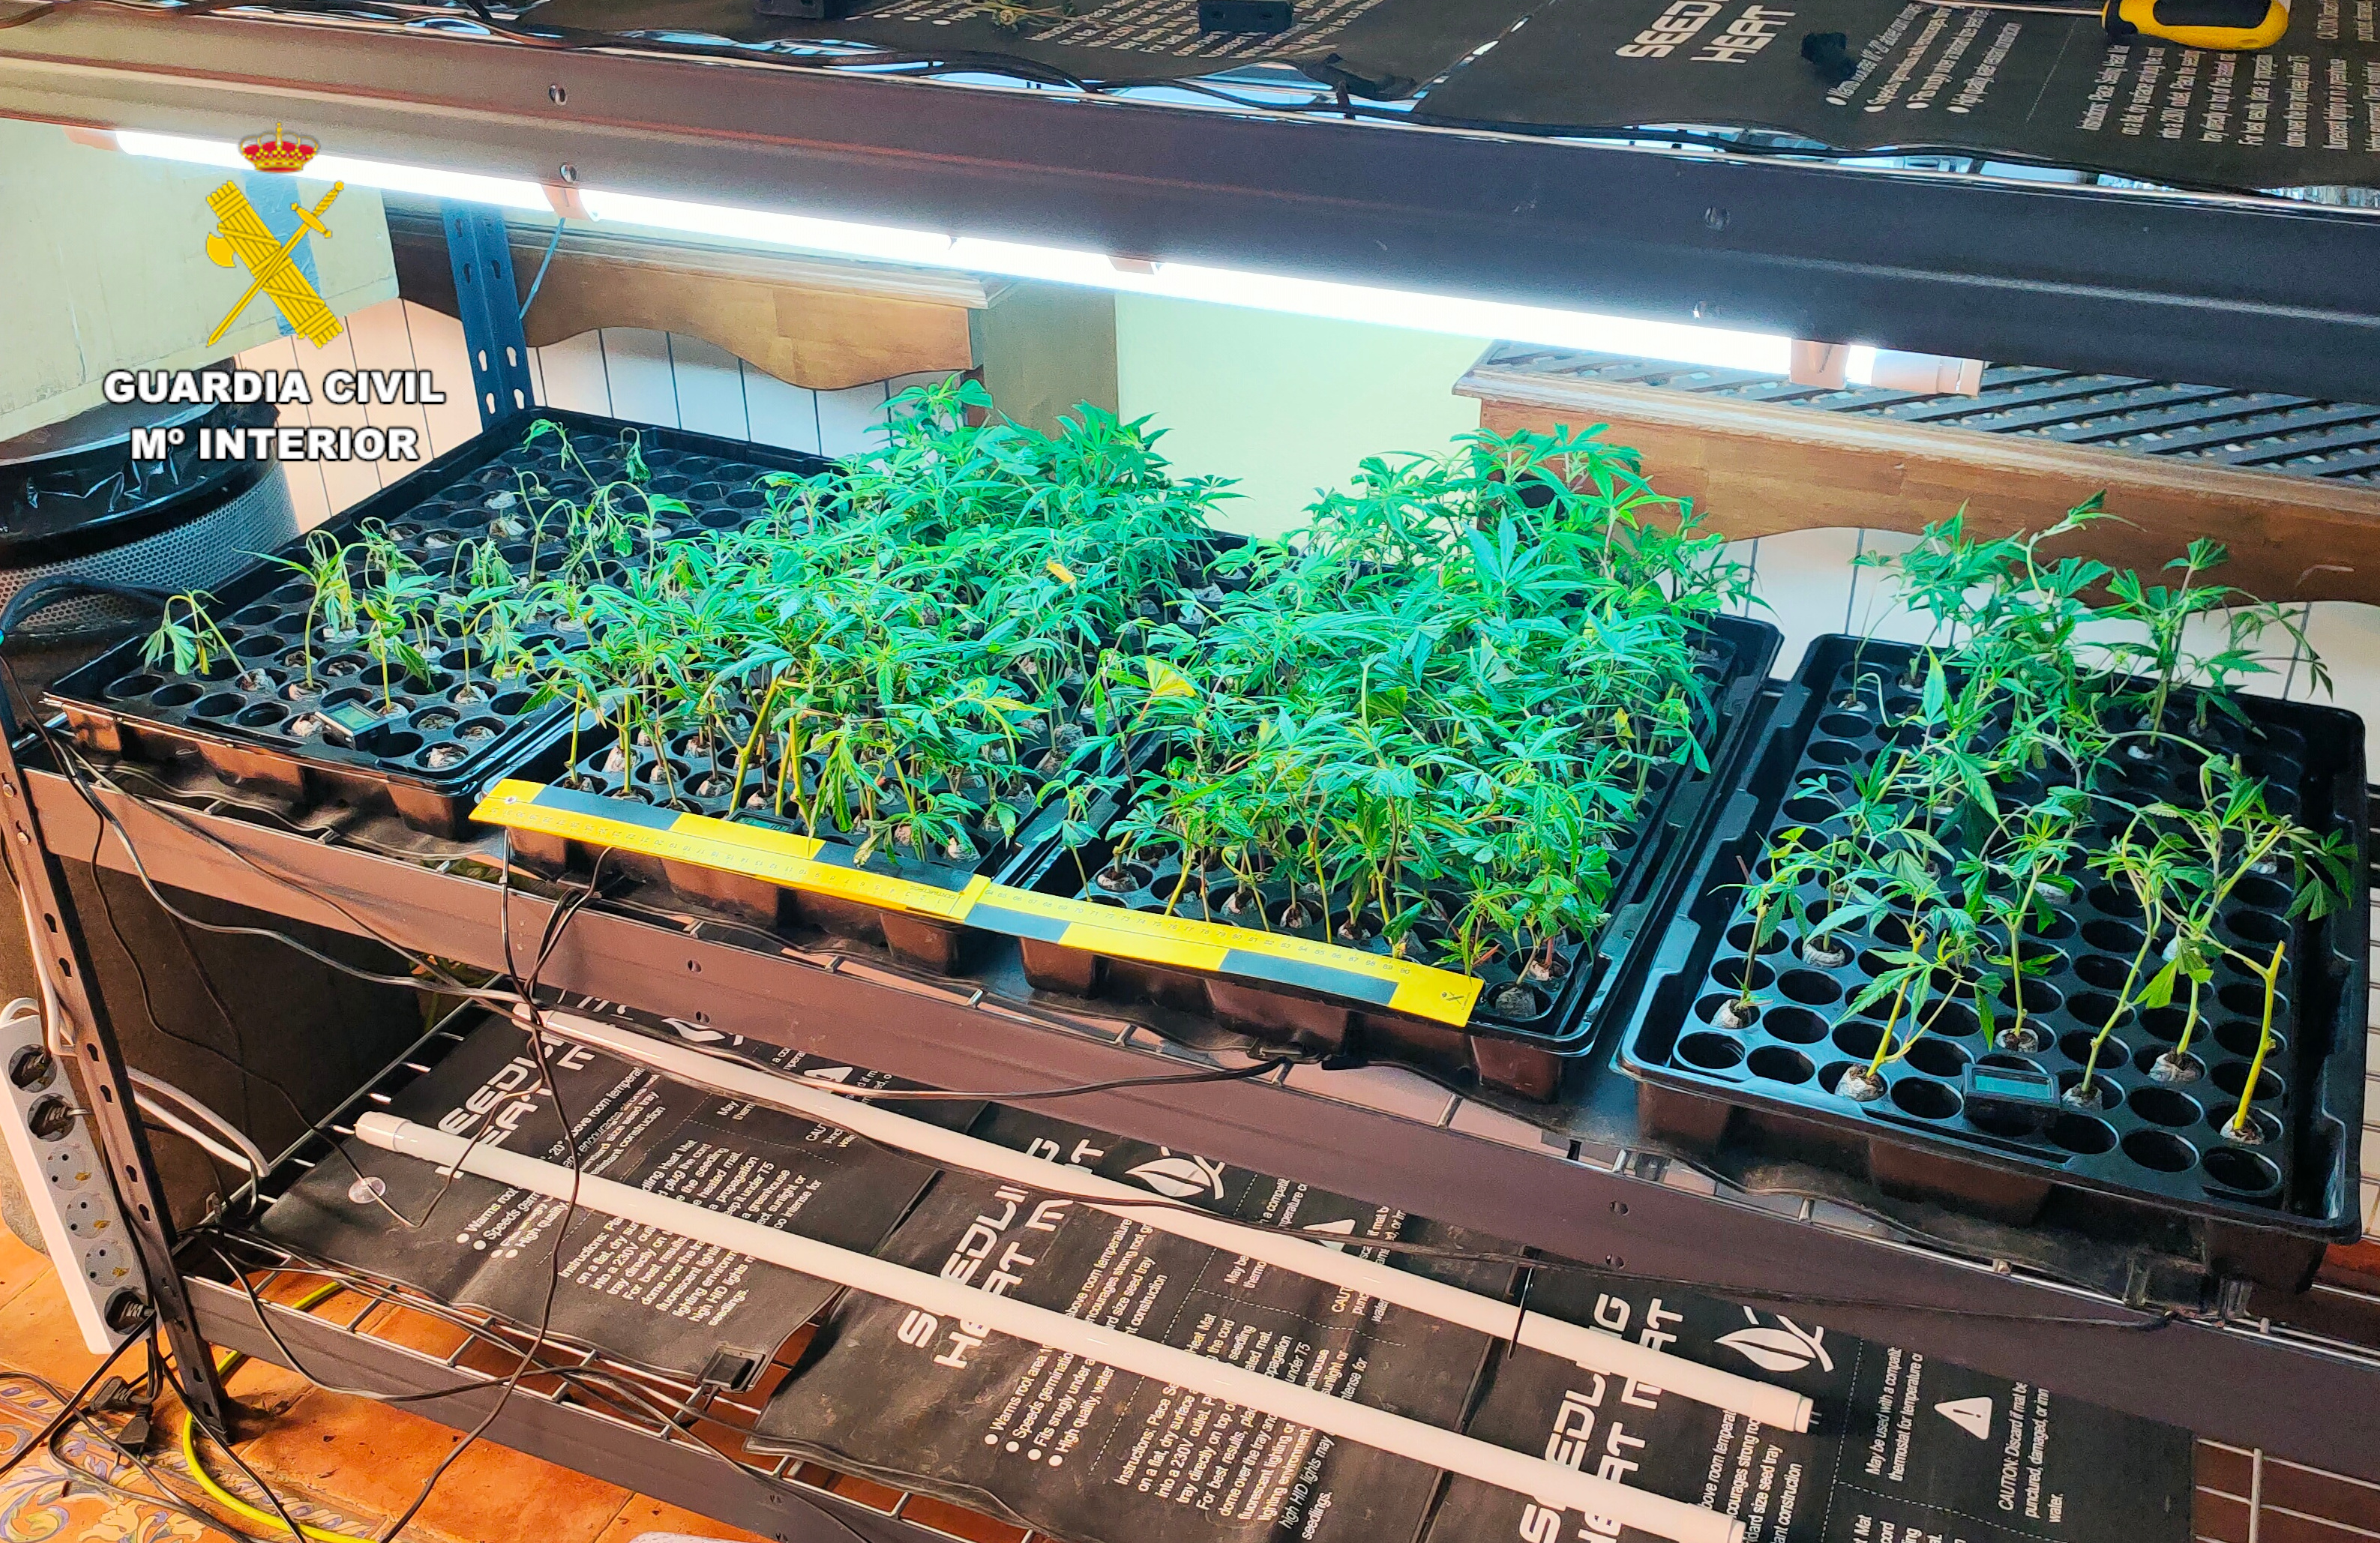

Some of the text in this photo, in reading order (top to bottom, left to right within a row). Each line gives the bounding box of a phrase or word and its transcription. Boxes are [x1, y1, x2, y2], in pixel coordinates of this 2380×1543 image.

[1615, 0, 1723, 58] SEED
[1689, 4, 1797, 64] HEAT
[464, 1098, 611, 1231] Warms root room
[658, 1152, 682, 1169] Heat
[676, 1140, 697, 1152] Mat
[717, 1101, 739, 1115] May
[483, 1209, 520, 1239] Speeds
[514, 1107, 666, 1247] High construction
[577, 1143, 712, 1284] on dry plug the cord
[589, 1148, 729, 1290] into 230V the seedling
[607, 1169, 727, 1294] tray directly on heated
[622, 1157, 760, 1300] For best propagation
[642, 1161, 774, 1305] dome over the under T5
[655, 1170, 790, 1311] fluorescent greenhouse
[672, 1175, 806, 1318] lighting sunlight or
[688, 1191, 812, 1322] high HID lights intense
[1224, 1254, 1251, 1284] May be
[708, 1290, 749, 1326] seedlings.
[990, 1212, 1132, 1431] Warms root area room temperature
[1012, 1244, 1138, 1438] Speeds strong
[1033, 1251, 1156, 1447] Fits snugly under size seed tray
[1055, 1275, 1168, 1452] High quality, water construction
[1114, 1314, 1216, 1485] Instructions: Place Heat Mat
[1138, 1319, 1235, 1491] on flat, dry surface the cord
[1155, 1479, 1175, 1497] into
[1171, 1438, 1194, 1468] 230V
[1228, 1325, 1256, 1360] seedling
[1176, 1332, 1272, 1503] tray directly on top mat.
[1218, 1342, 1310, 1516] dome over the tray under T5
[1257, 1488, 1287, 1521] lighting
[1336, 1350, 1348, 1360] or
[1278, 1357, 1368, 1529] high HID lights may for
[1737, 1431, 1759, 1467] strong
[1865, 1395, 1893, 1475] May be used with
[1887, 1362, 1921, 1482] thermostat for temperature
[2005, 1419, 2022, 1457] Discard
[2010, 1410, 2024, 1420] if
[2013, 1393, 2026, 1412] mat
[1196, 1431, 1248, 1510] For best results,
[1238, 1423, 1296, 1519] fluorescent lighting or
[1302, 1492, 1332, 1540] seedlings.
[1708, 1455, 1725, 1482] room
[1751, 1445, 1783, 1513] size seed tray
[1778, 1464, 1802, 1525] construction
[1998, 1458, 2019, 1510] CAUTION:
[2025, 1405, 2049, 1518] punctured, damaged, or
[2048, 1494, 2063, 1522] water.
